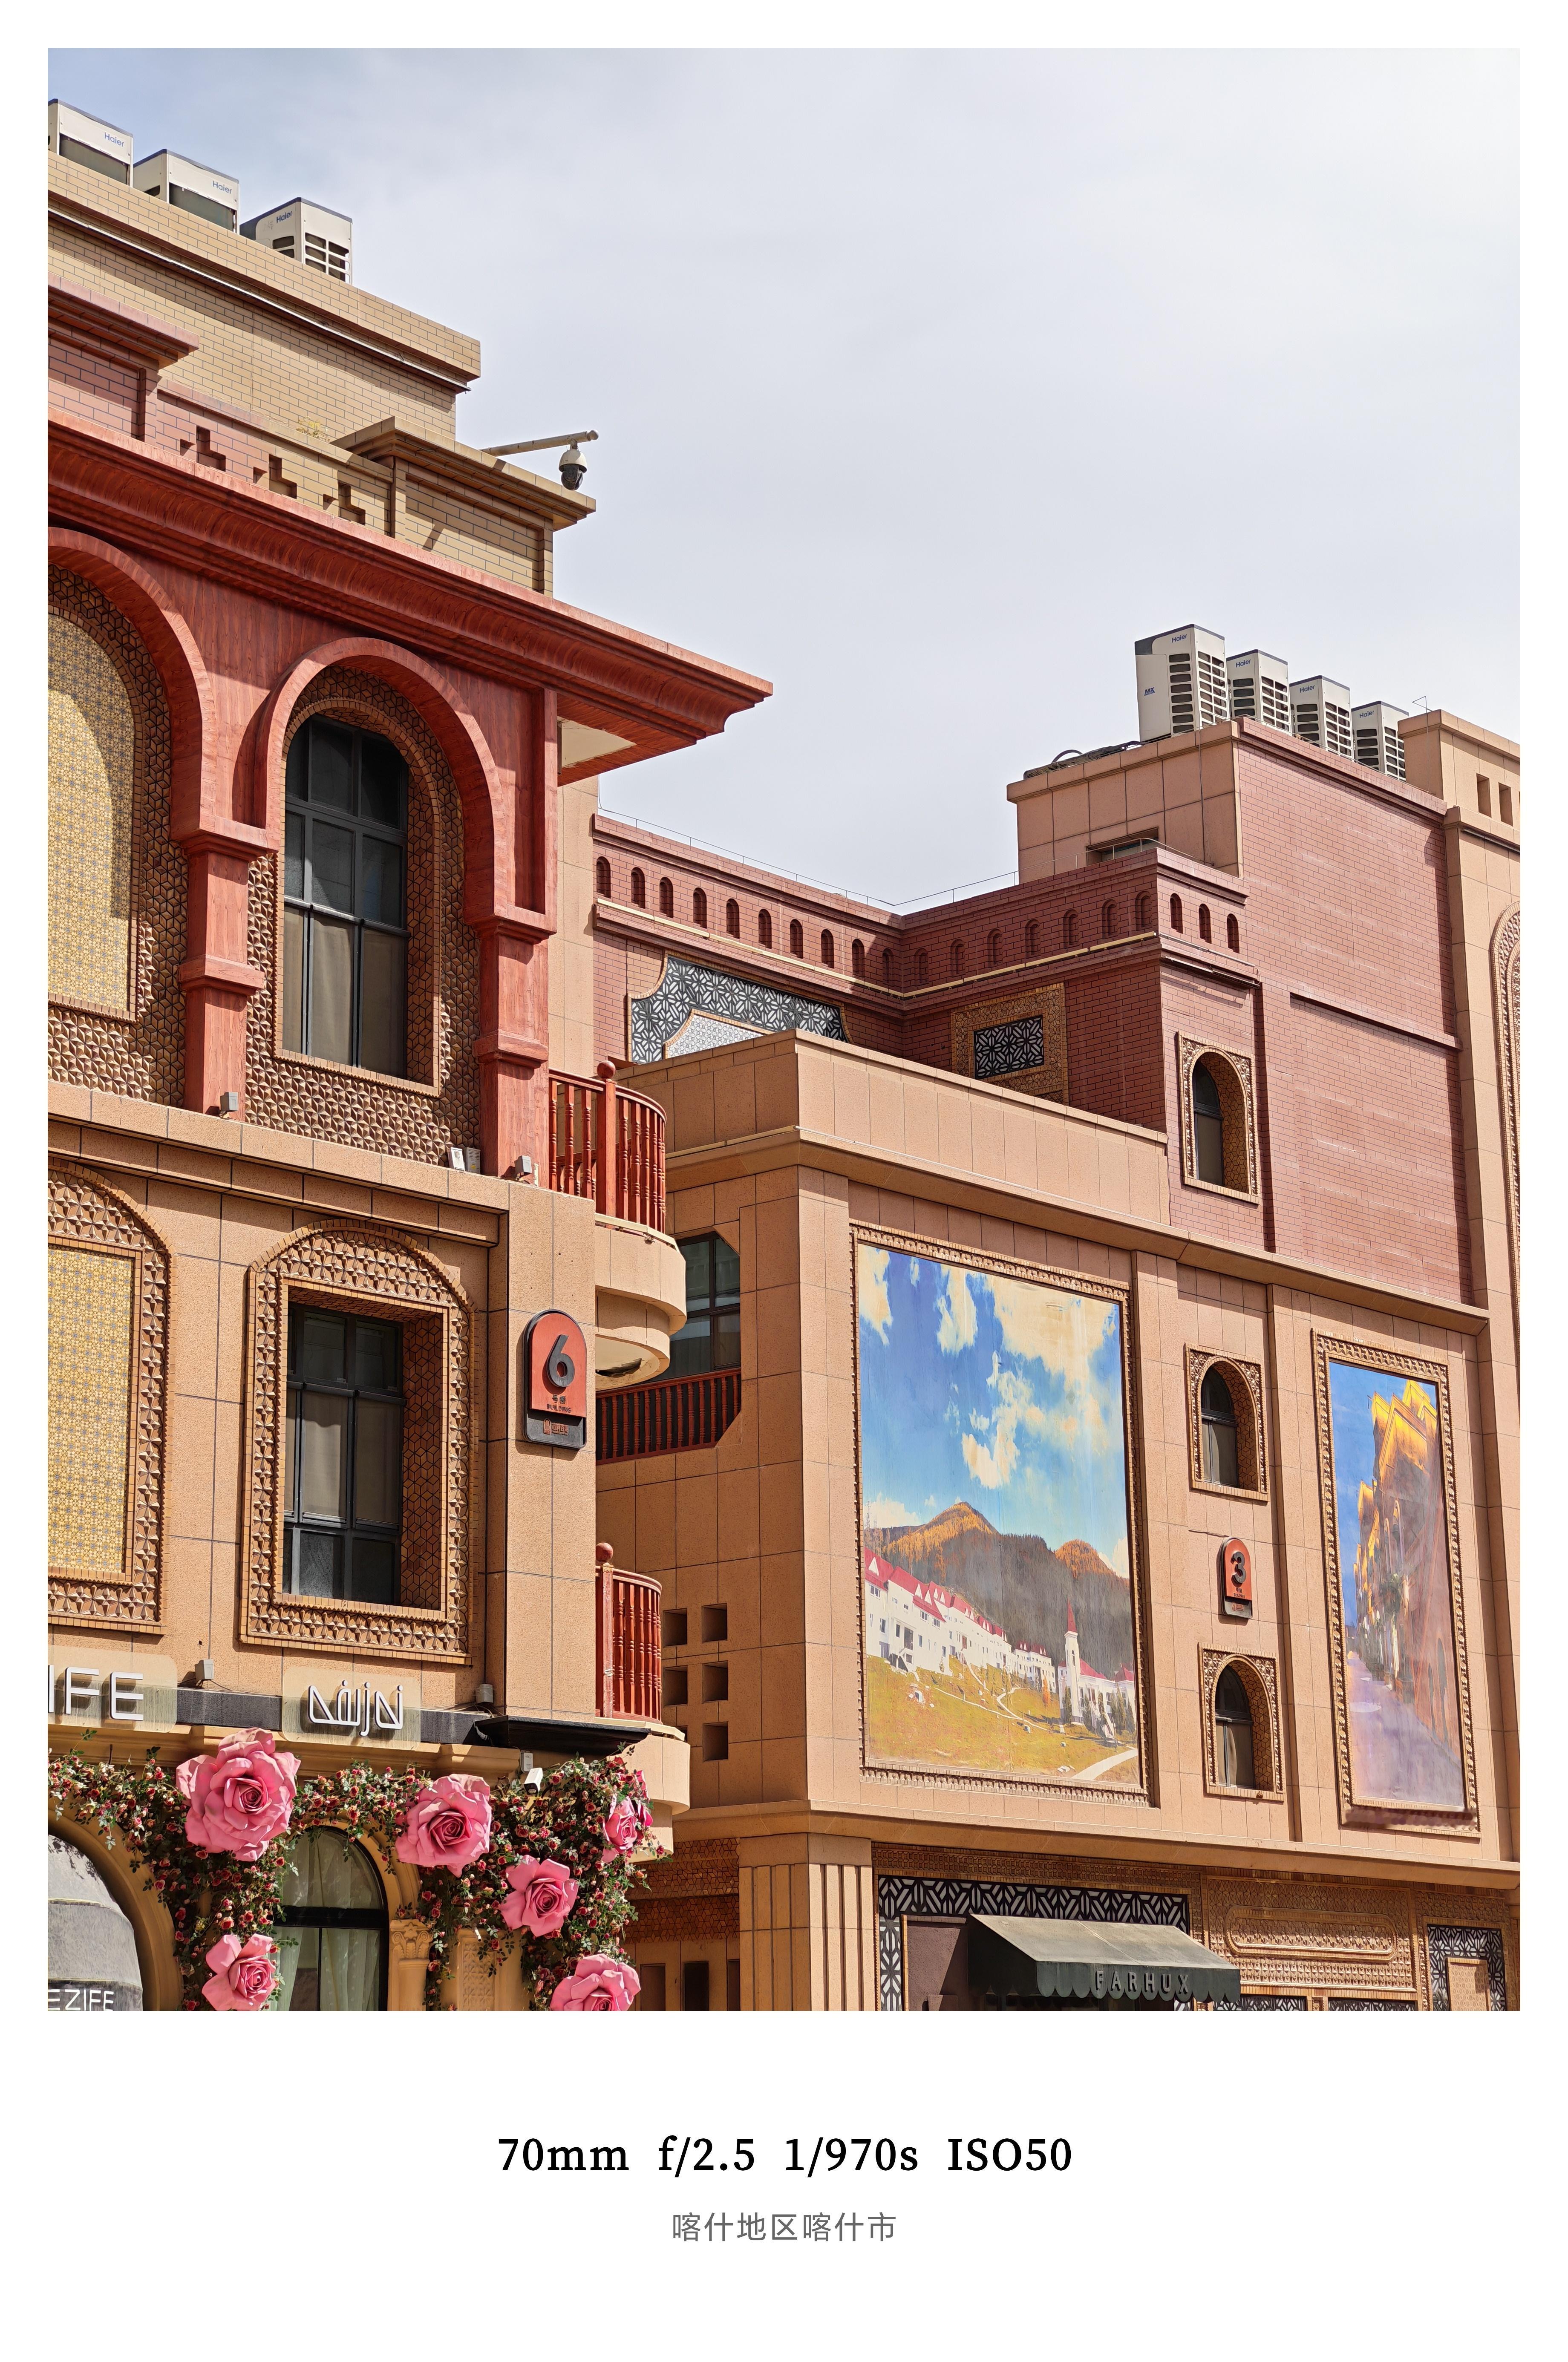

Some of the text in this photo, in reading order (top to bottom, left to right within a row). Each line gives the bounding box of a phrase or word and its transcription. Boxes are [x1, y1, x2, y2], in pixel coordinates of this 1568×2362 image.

[104, 132, 124, 147] Haier
[213, 180, 232, 194] Haier
[276, 210, 292, 224] Haier
[1172, 634, 1187, 643] Haier
[1236, 659, 1251, 668] Haier
[1300, 685, 1315, 693] Haier
[1359, 710, 1374, 719] Haier
[546, 1334, 575, 1388] 6
[546, 1403, 572, 1413] BUILDING
[1230, 1551, 1246, 1584] 3
[1095, 1970, 1189, 1994] FARHUX
